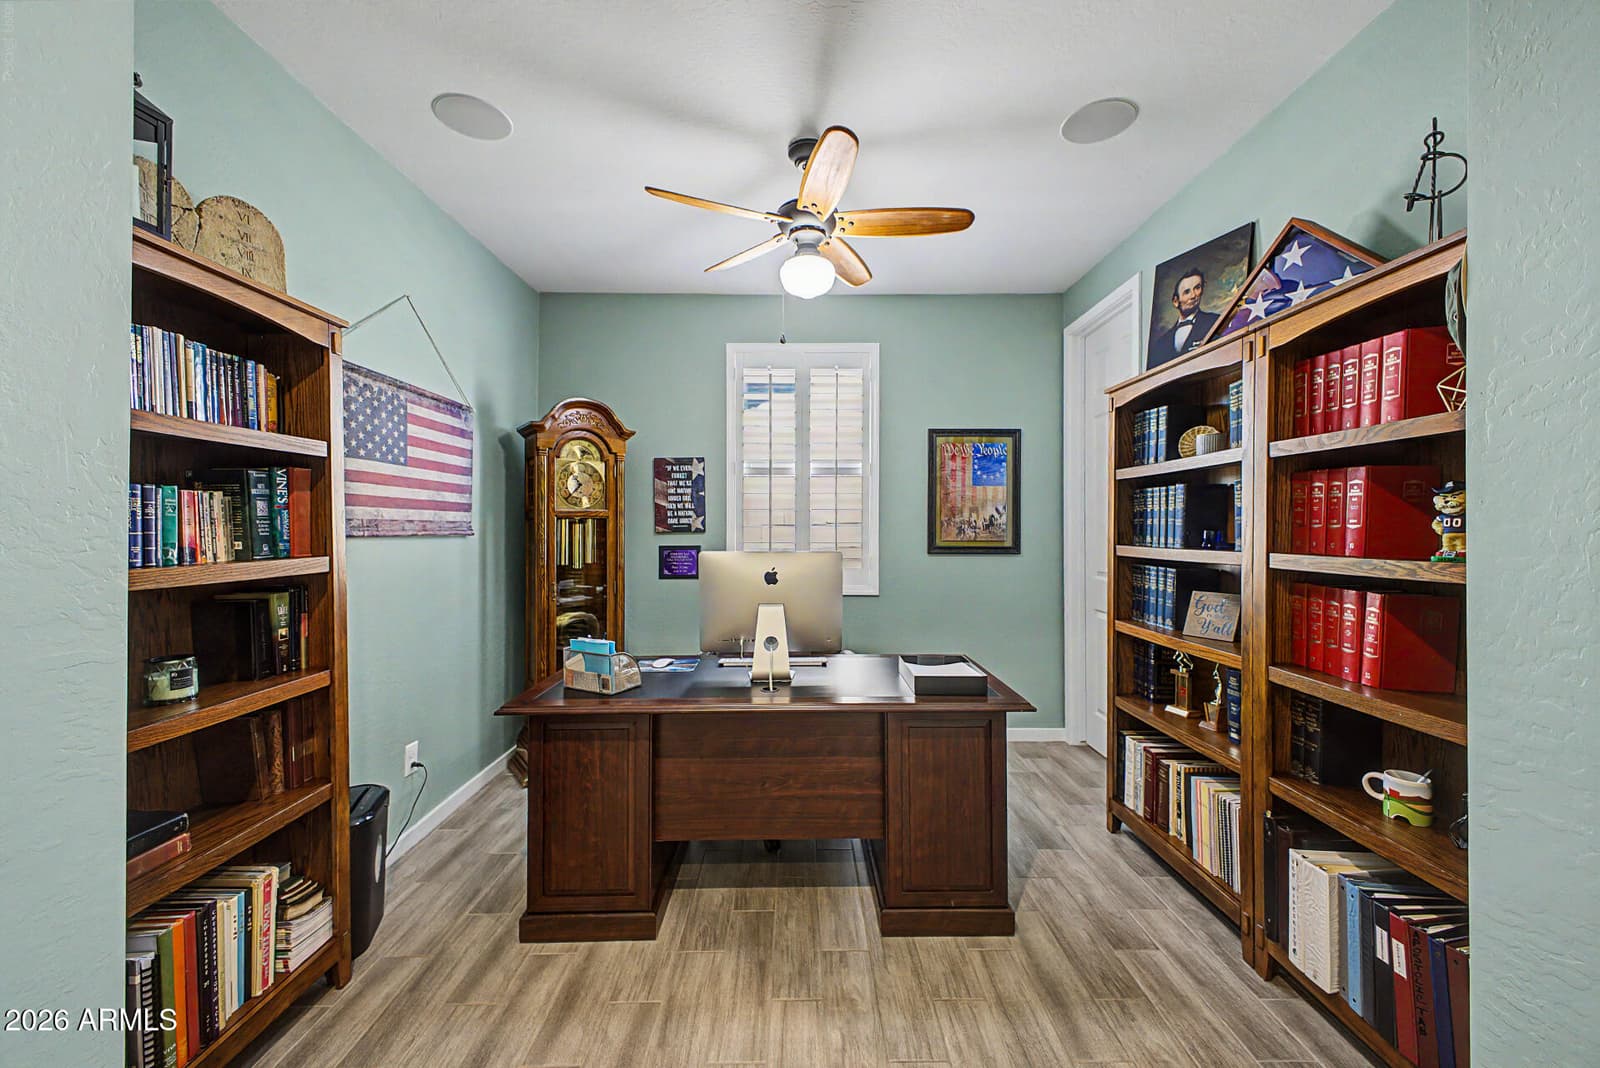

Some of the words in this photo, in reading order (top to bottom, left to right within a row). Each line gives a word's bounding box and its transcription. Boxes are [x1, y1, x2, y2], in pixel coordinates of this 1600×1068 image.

[237, 211, 250, 225] VI
[237, 229, 252, 243] VII
[974, 443, 1008, 459] People
[276, 468, 289, 504] VINE'S
